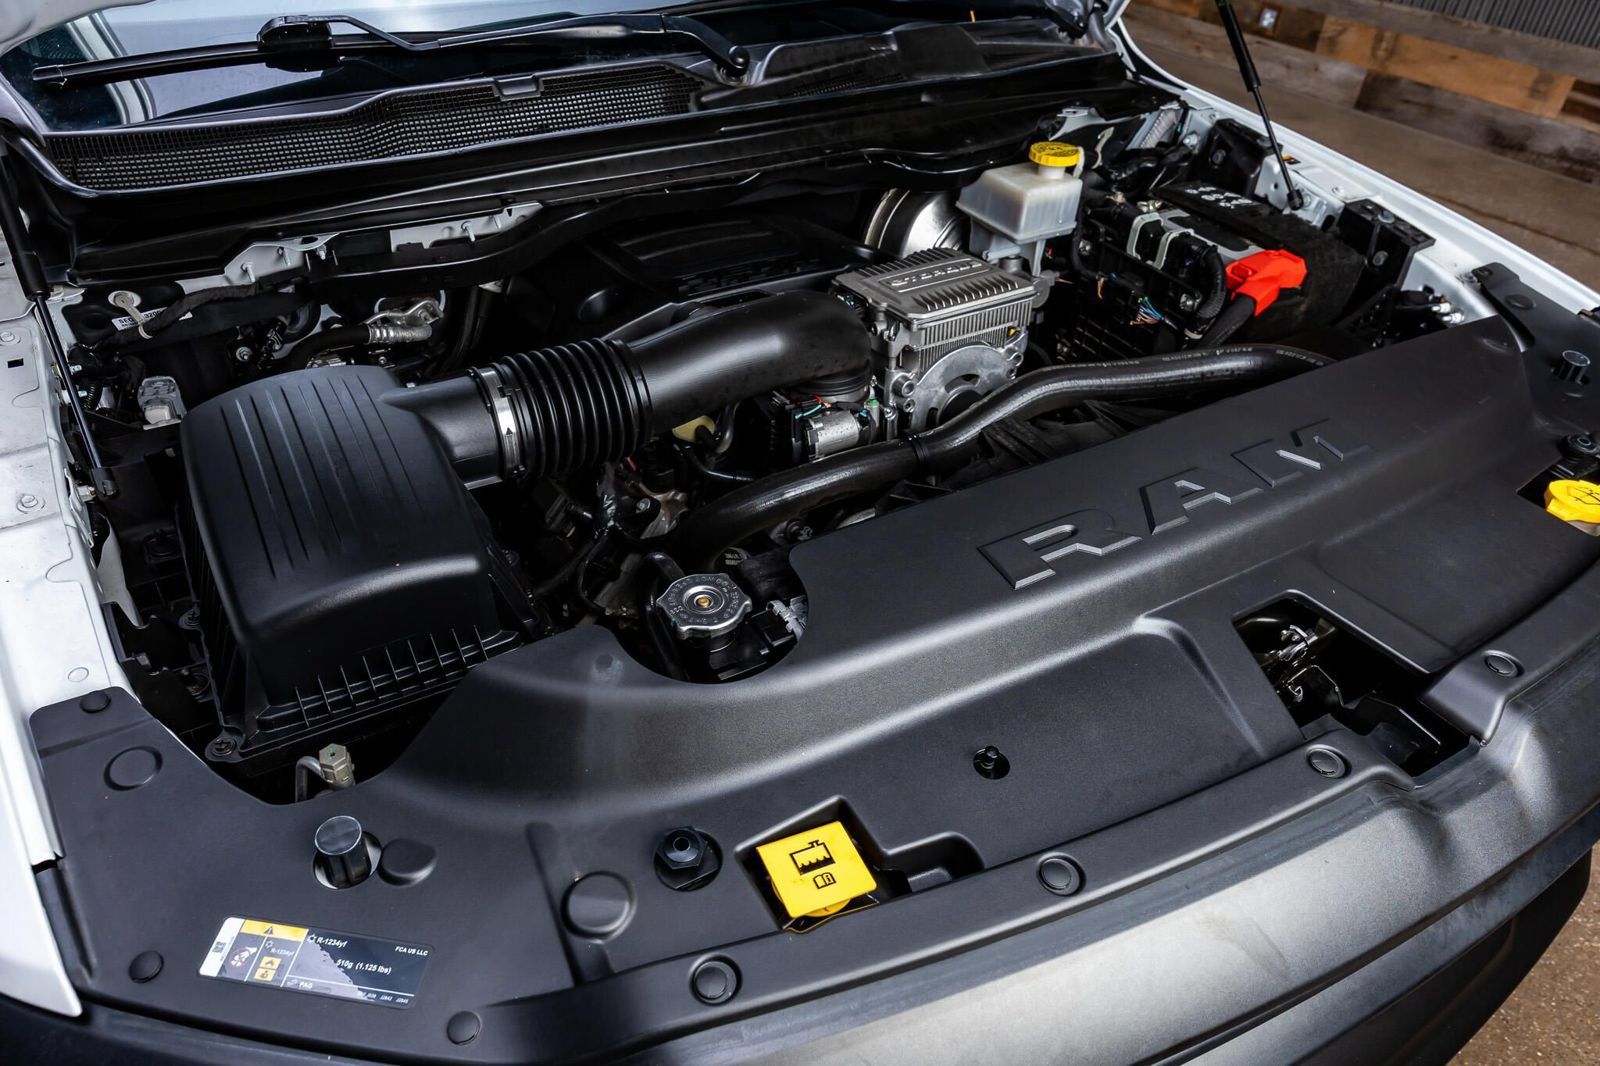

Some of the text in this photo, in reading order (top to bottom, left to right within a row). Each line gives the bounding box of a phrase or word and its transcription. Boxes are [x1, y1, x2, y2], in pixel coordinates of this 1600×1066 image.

[976, 418, 1371, 590] RAM
[316, 936, 348, 948] R-1234yf
[336, 959, 354, 969] 510g
[355, 961, 377, 972] (1.125
